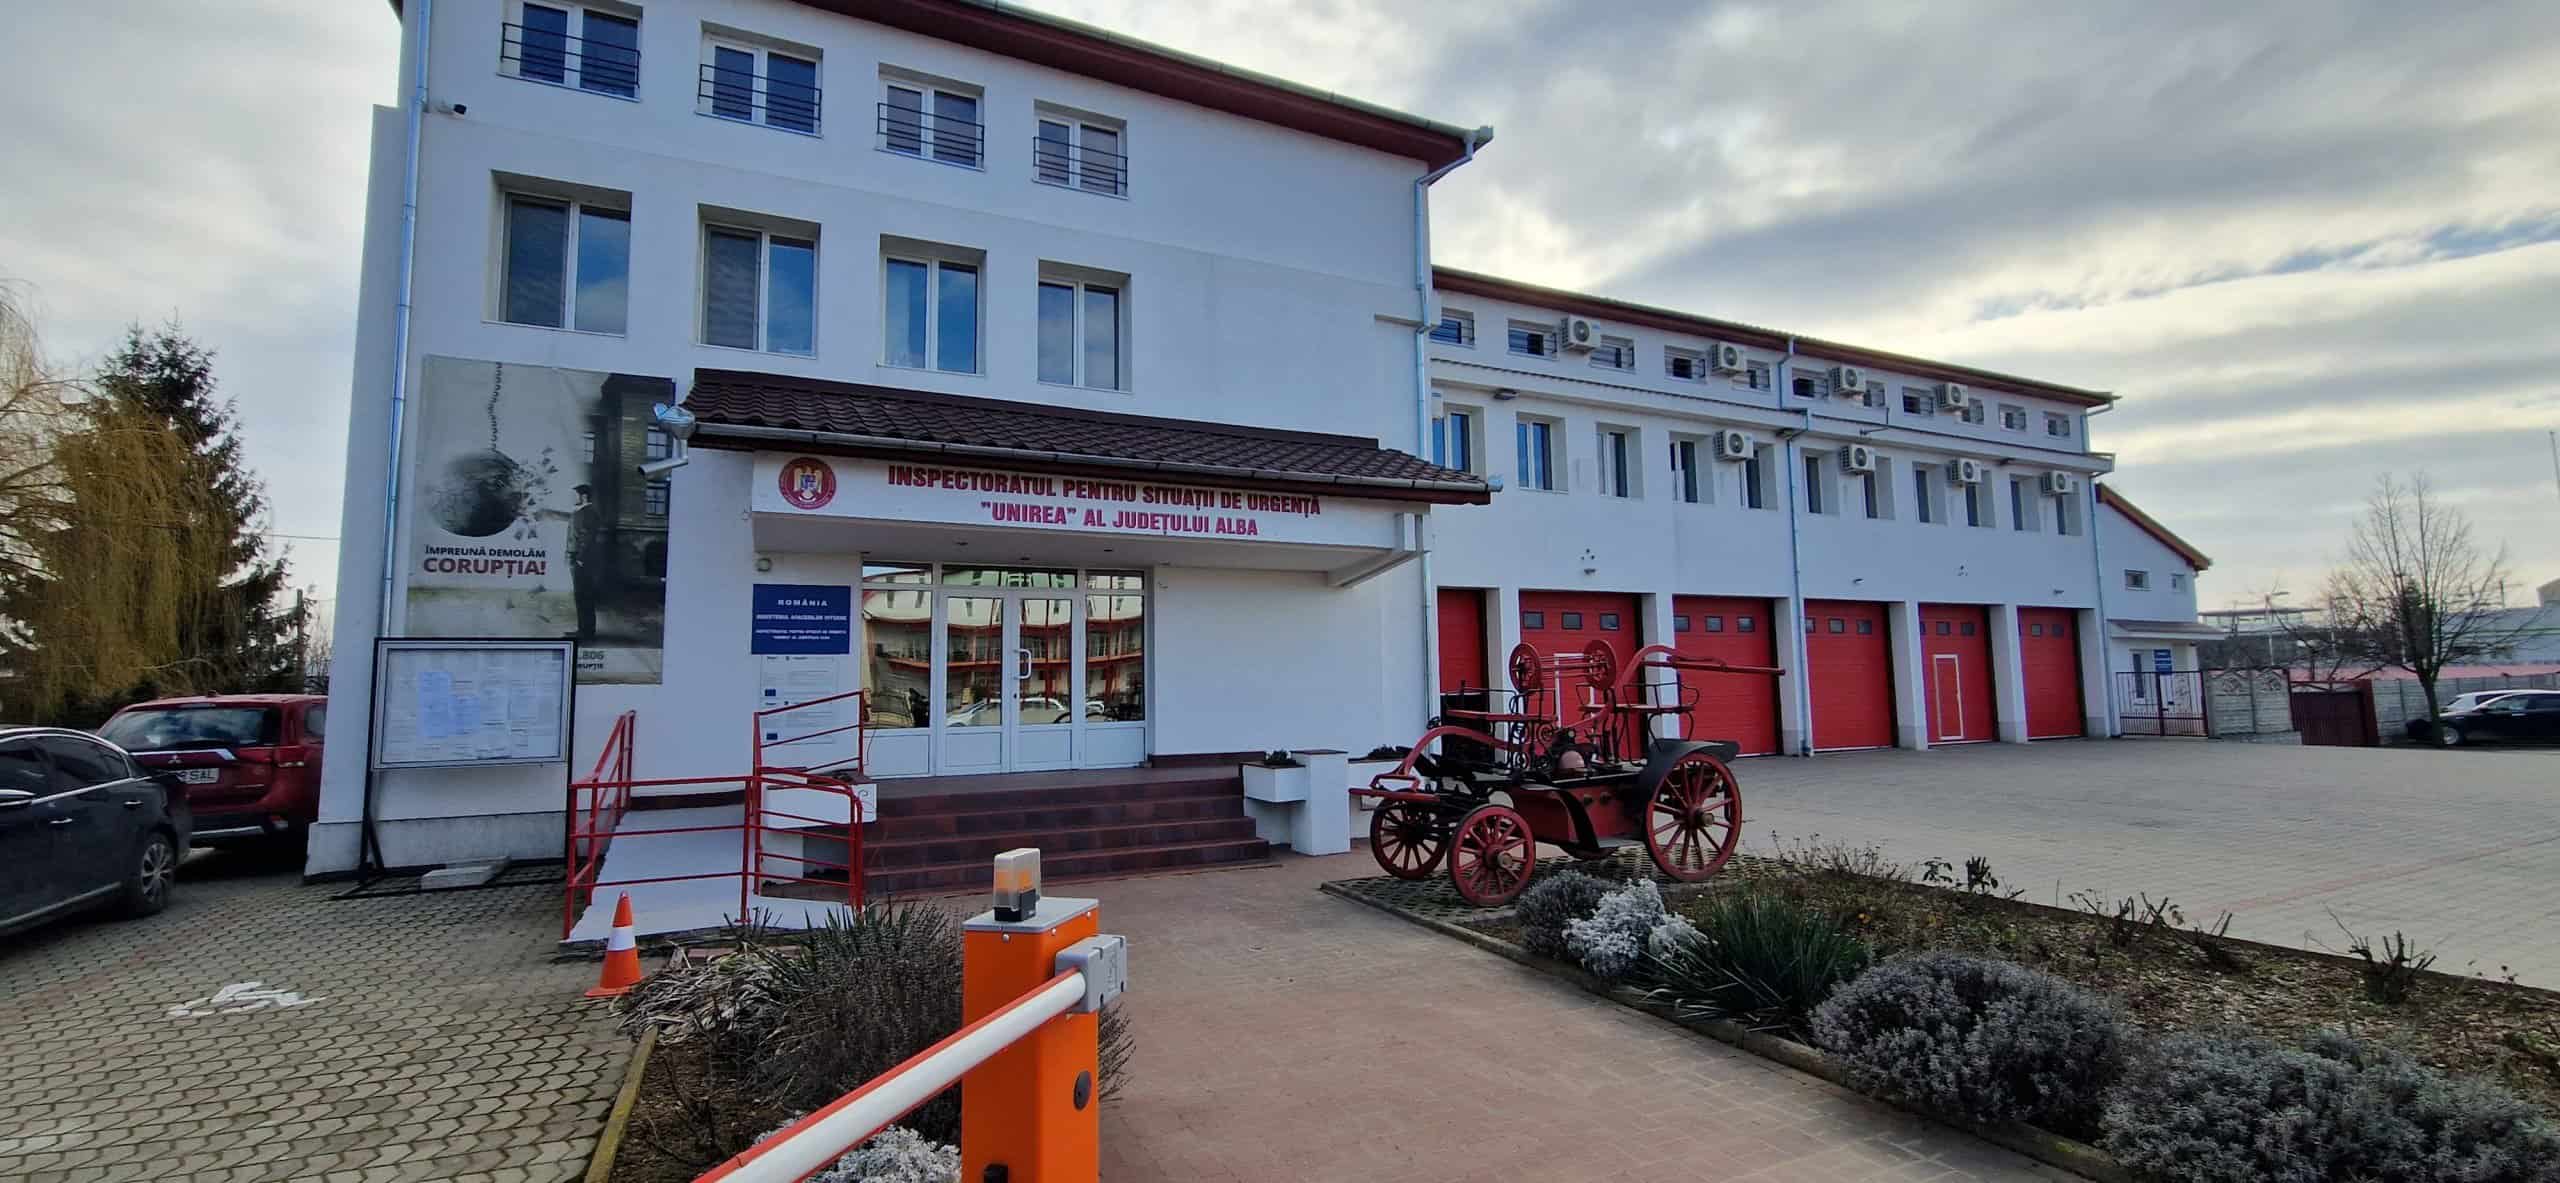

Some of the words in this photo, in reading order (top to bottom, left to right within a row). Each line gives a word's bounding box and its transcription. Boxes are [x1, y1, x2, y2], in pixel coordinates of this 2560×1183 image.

[888, 465, 1056, 497] INSPECTORATUL
[1062, 479, 1136, 502] PENTRU
[1142, 485, 1215, 511] SITUAȚII
[1220, 491, 1242, 511] DE
[1083, 508, 1107, 528] AL
[1112, 511, 1209, 536] JUDEȚULUI
[1215, 517, 1258, 536] ALBA
[423, 557, 547, 579] CORUPȚIA!
